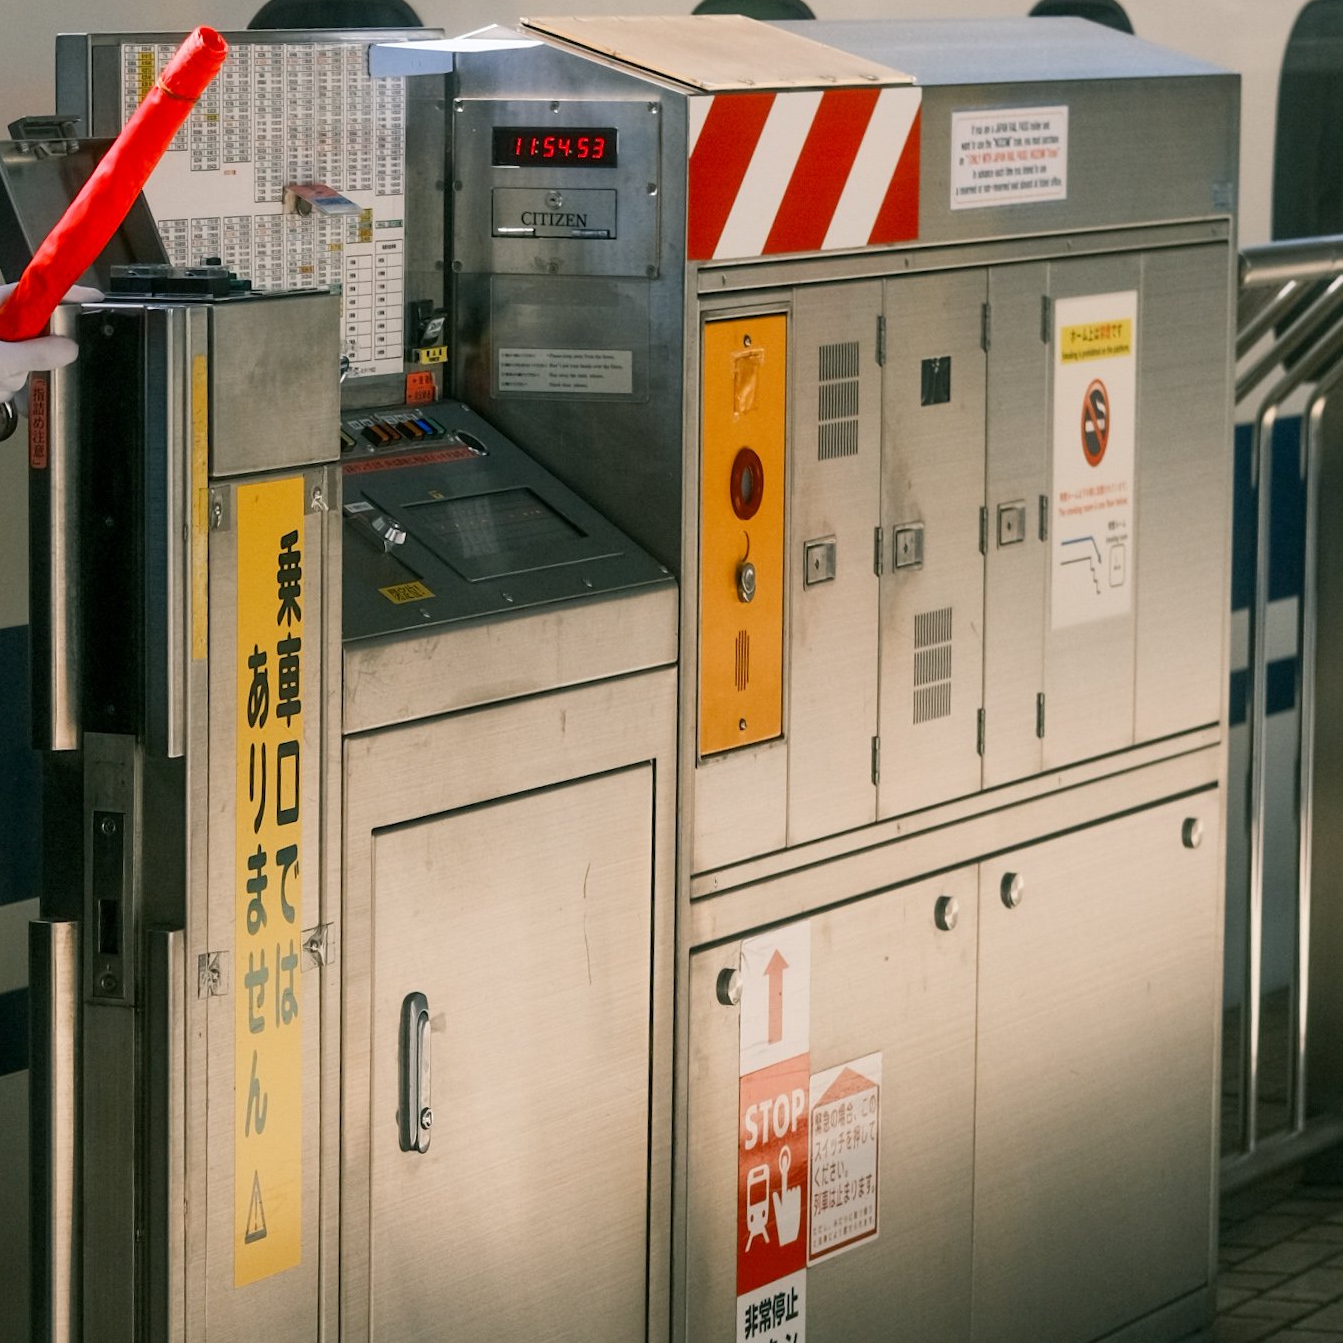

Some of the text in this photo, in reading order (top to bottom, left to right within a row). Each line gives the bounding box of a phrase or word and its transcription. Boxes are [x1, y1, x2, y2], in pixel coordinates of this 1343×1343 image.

[521, 211, 588, 228] CITIZEN
[275, 530, 302, 1028] 乗車口では
[244, 644, 270, 1138] ありません
[744, 1088, 805, 1151] STOP
[814, 1161, 848, 1188] ください。
[745, 1286, 799, 1340] 非常停止
